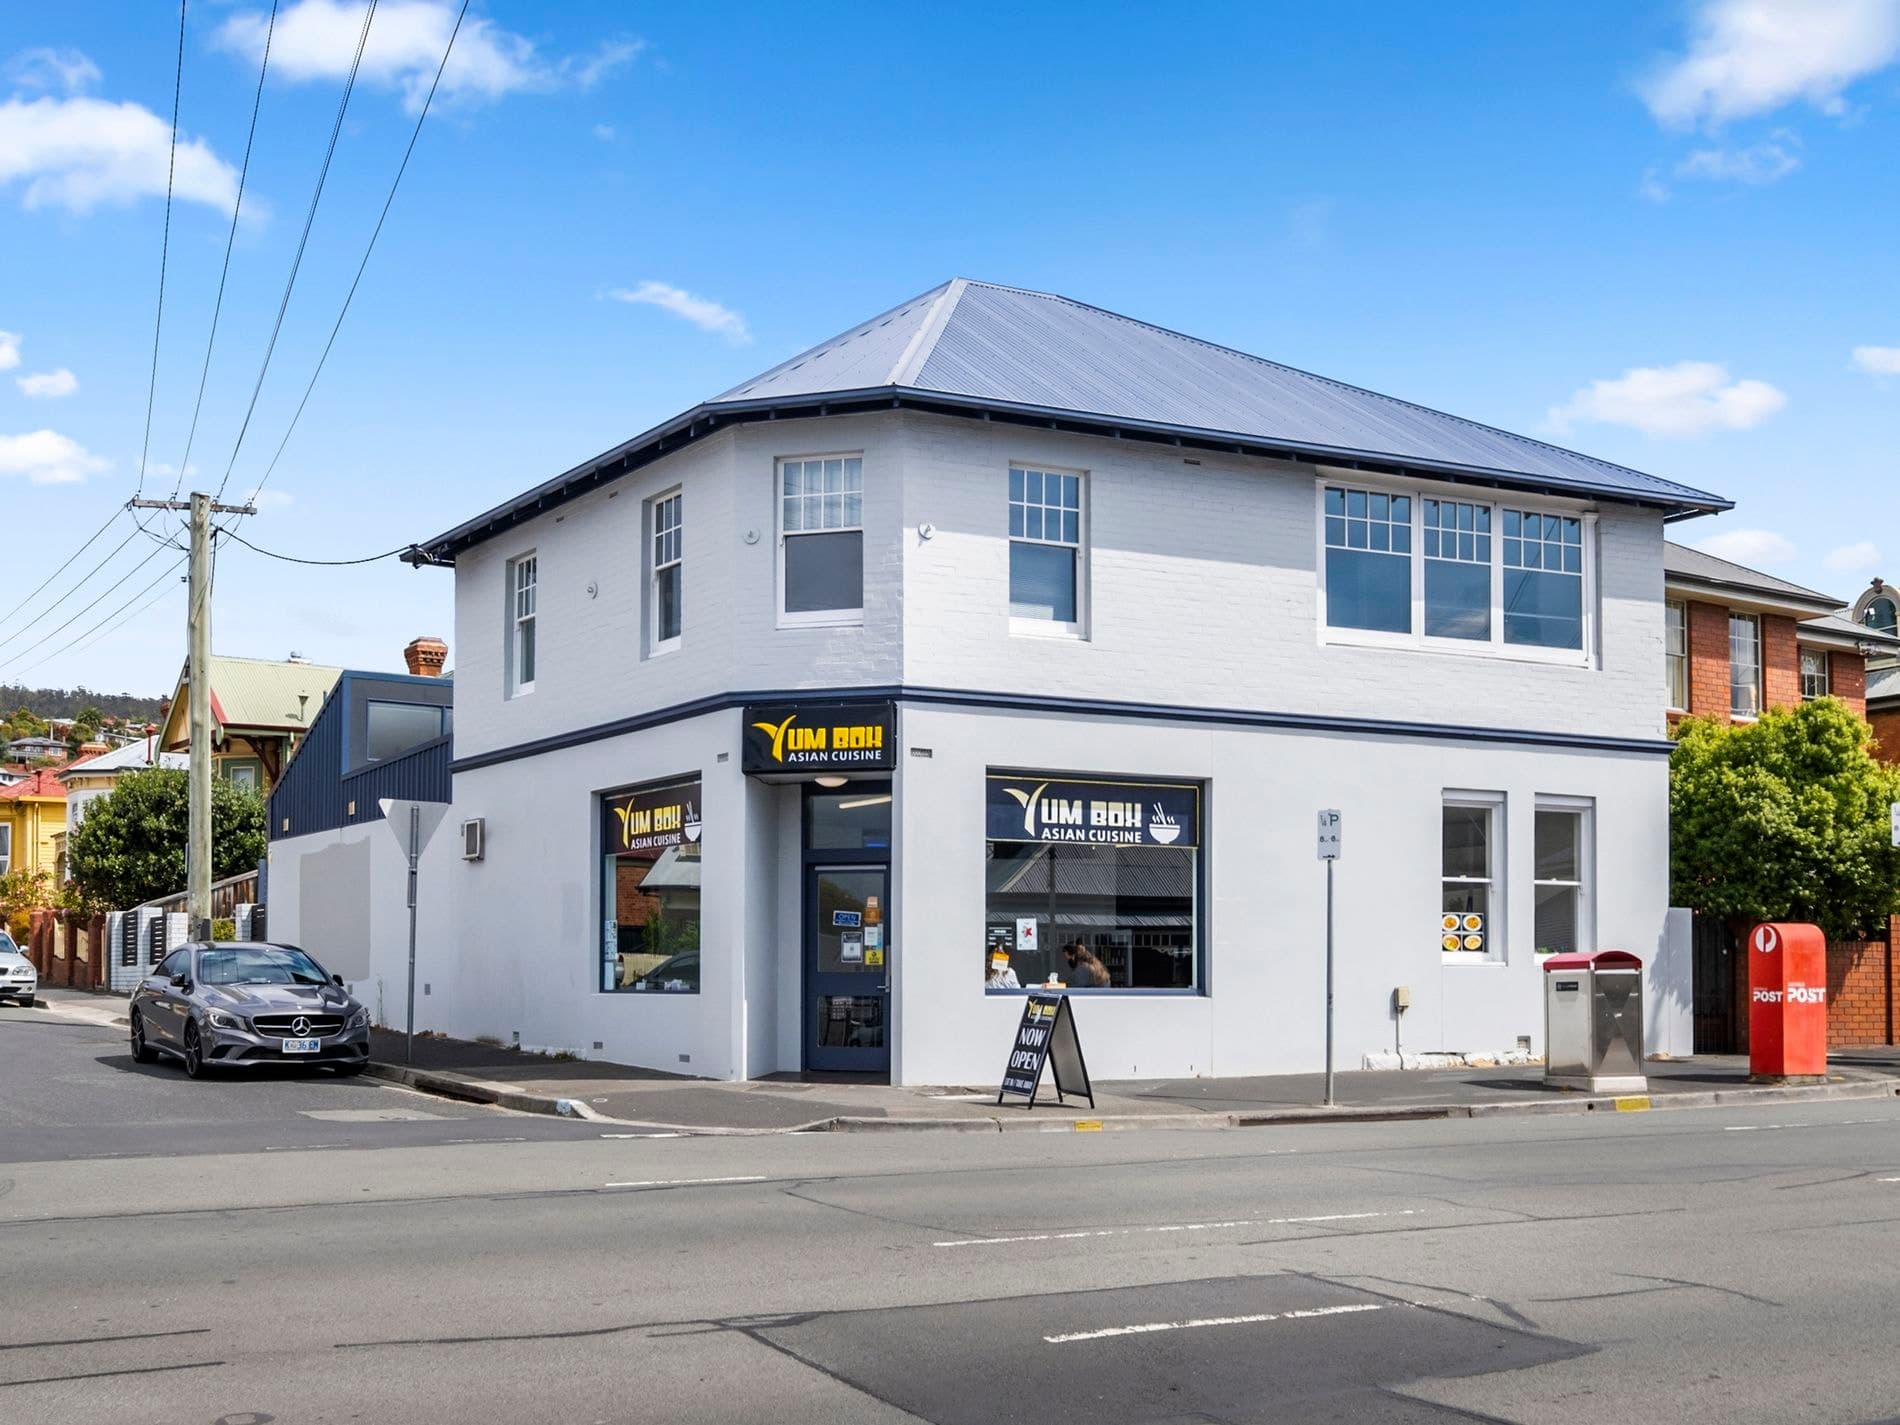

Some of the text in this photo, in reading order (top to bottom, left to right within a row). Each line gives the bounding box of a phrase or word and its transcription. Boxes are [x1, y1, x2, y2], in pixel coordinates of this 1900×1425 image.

[752, 715, 826, 762] YUM
[788, 750, 882, 762] ASIAN CUISINE
[1002, 782, 1082, 837] YUM
[613, 797, 651, 848] YUM
[630, 832, 681, 850] ASIAN CUISINE
[1041, 827, 1142, 843] ASIAN CUISINE
[1753, 991, 1783, 1002] POST
[1787, 987, 1826, 1003] POST
[1019, 1027, 1046, 1047] NOW
[1011, 1050, 1041, 1071] OPEN
